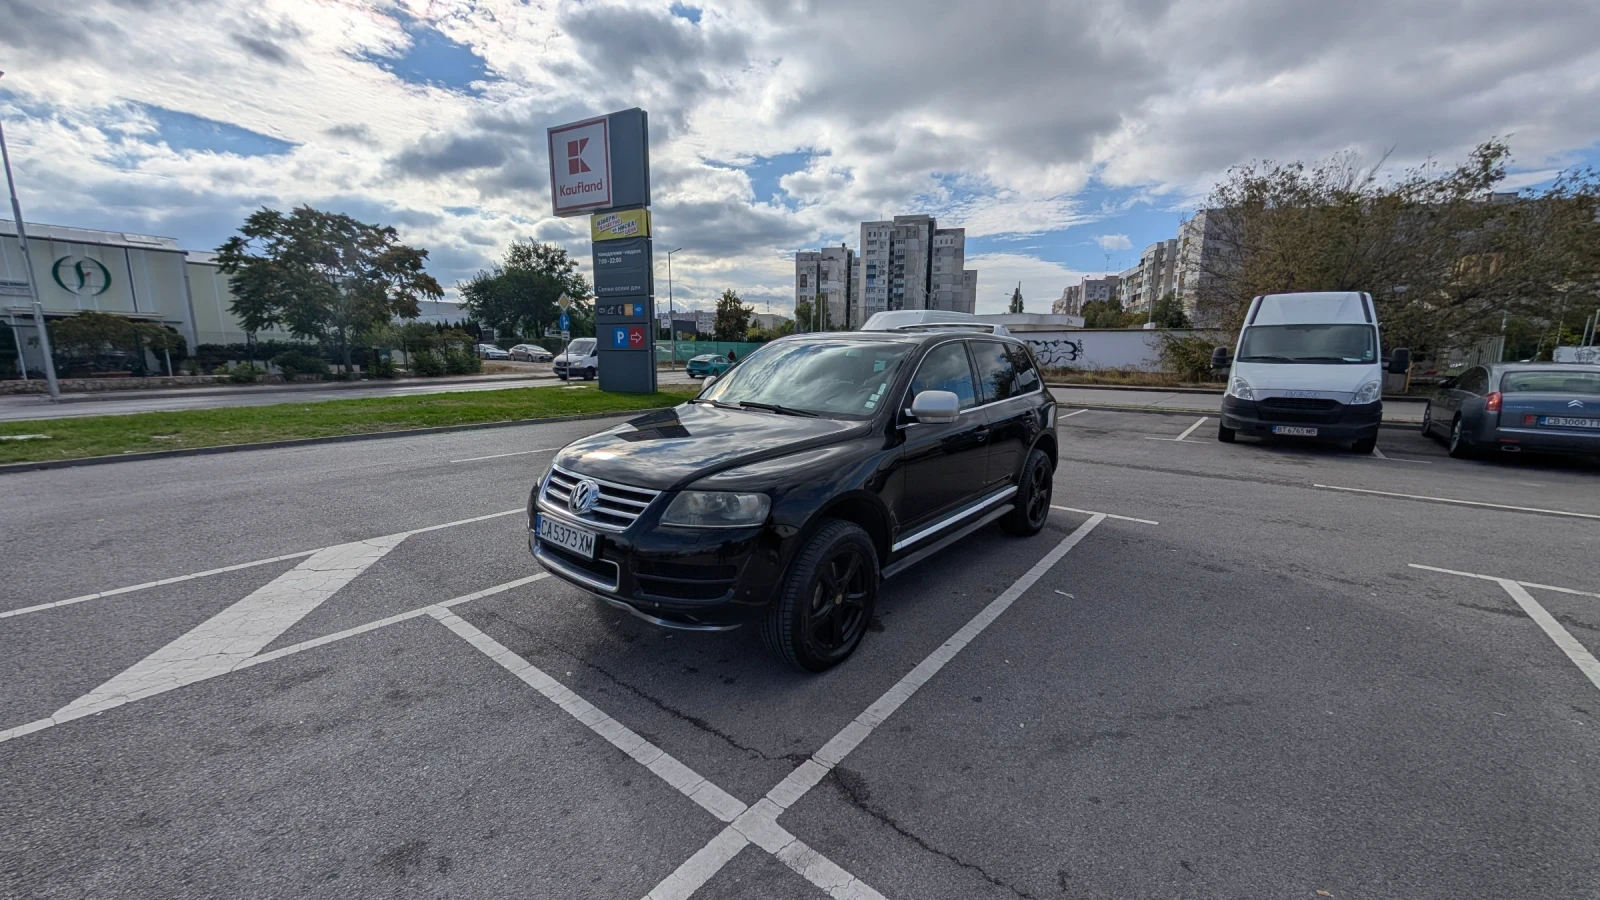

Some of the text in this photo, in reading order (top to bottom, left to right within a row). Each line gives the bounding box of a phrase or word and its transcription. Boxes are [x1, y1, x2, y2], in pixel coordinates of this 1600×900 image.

[559, 178, 603, 197] Kaufland
[617, 331, 625, 344] P
[1547, 417, 1560, 425] CB
[1562, 418, 1587, 426] 3000
[541, 519, 552, 539] CA
[553, 524, 578, 548] 5373
[578, 533, 593, 555] XM
